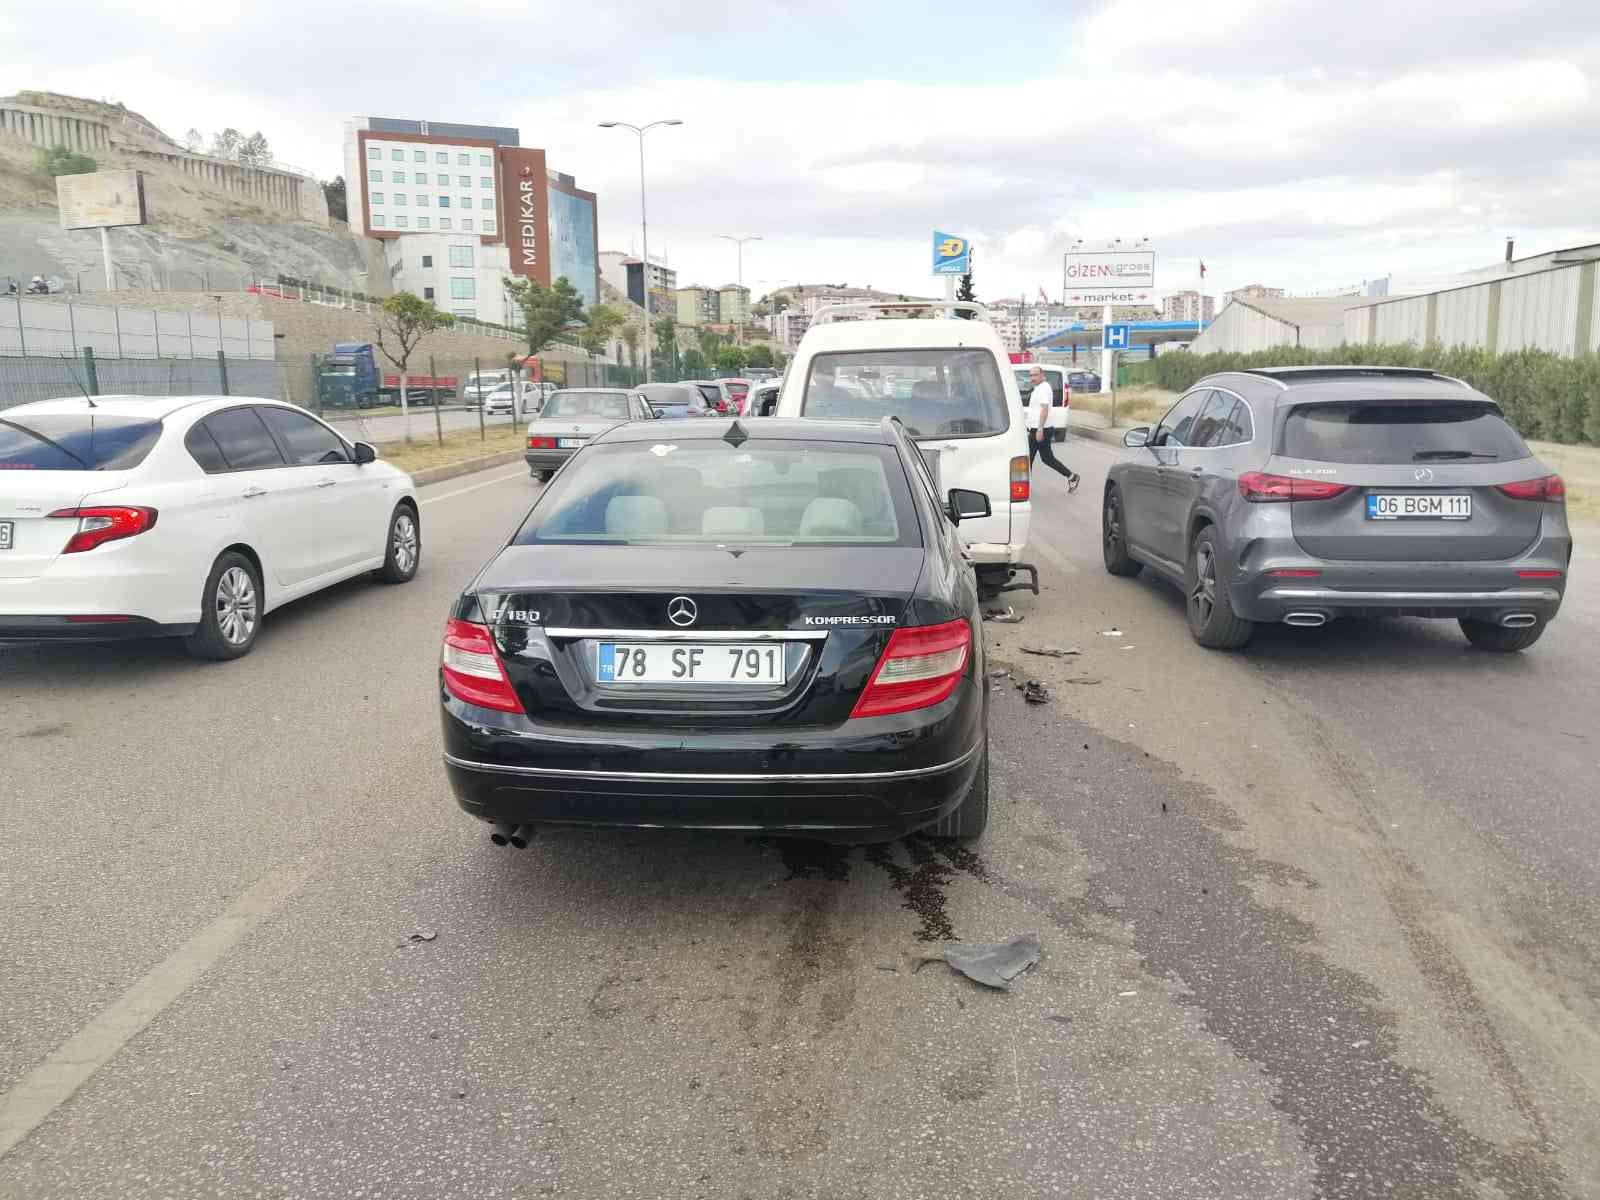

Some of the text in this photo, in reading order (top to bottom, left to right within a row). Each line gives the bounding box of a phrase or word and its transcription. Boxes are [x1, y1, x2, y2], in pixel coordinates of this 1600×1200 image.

[519, 180, 536, 265] MEDİKAR
[1083, 292, 1134, 302] market
[1108, 327, 1125, 345] H
[1378, 498, 1398, 513] 06
[1404, 498, 1442, 513] BGM
[1449, 497, 1469, 513] 111
[805, 615, 896, 625] KOMPRESSOR
[616, 648, 775, 678] 78 SF 791
